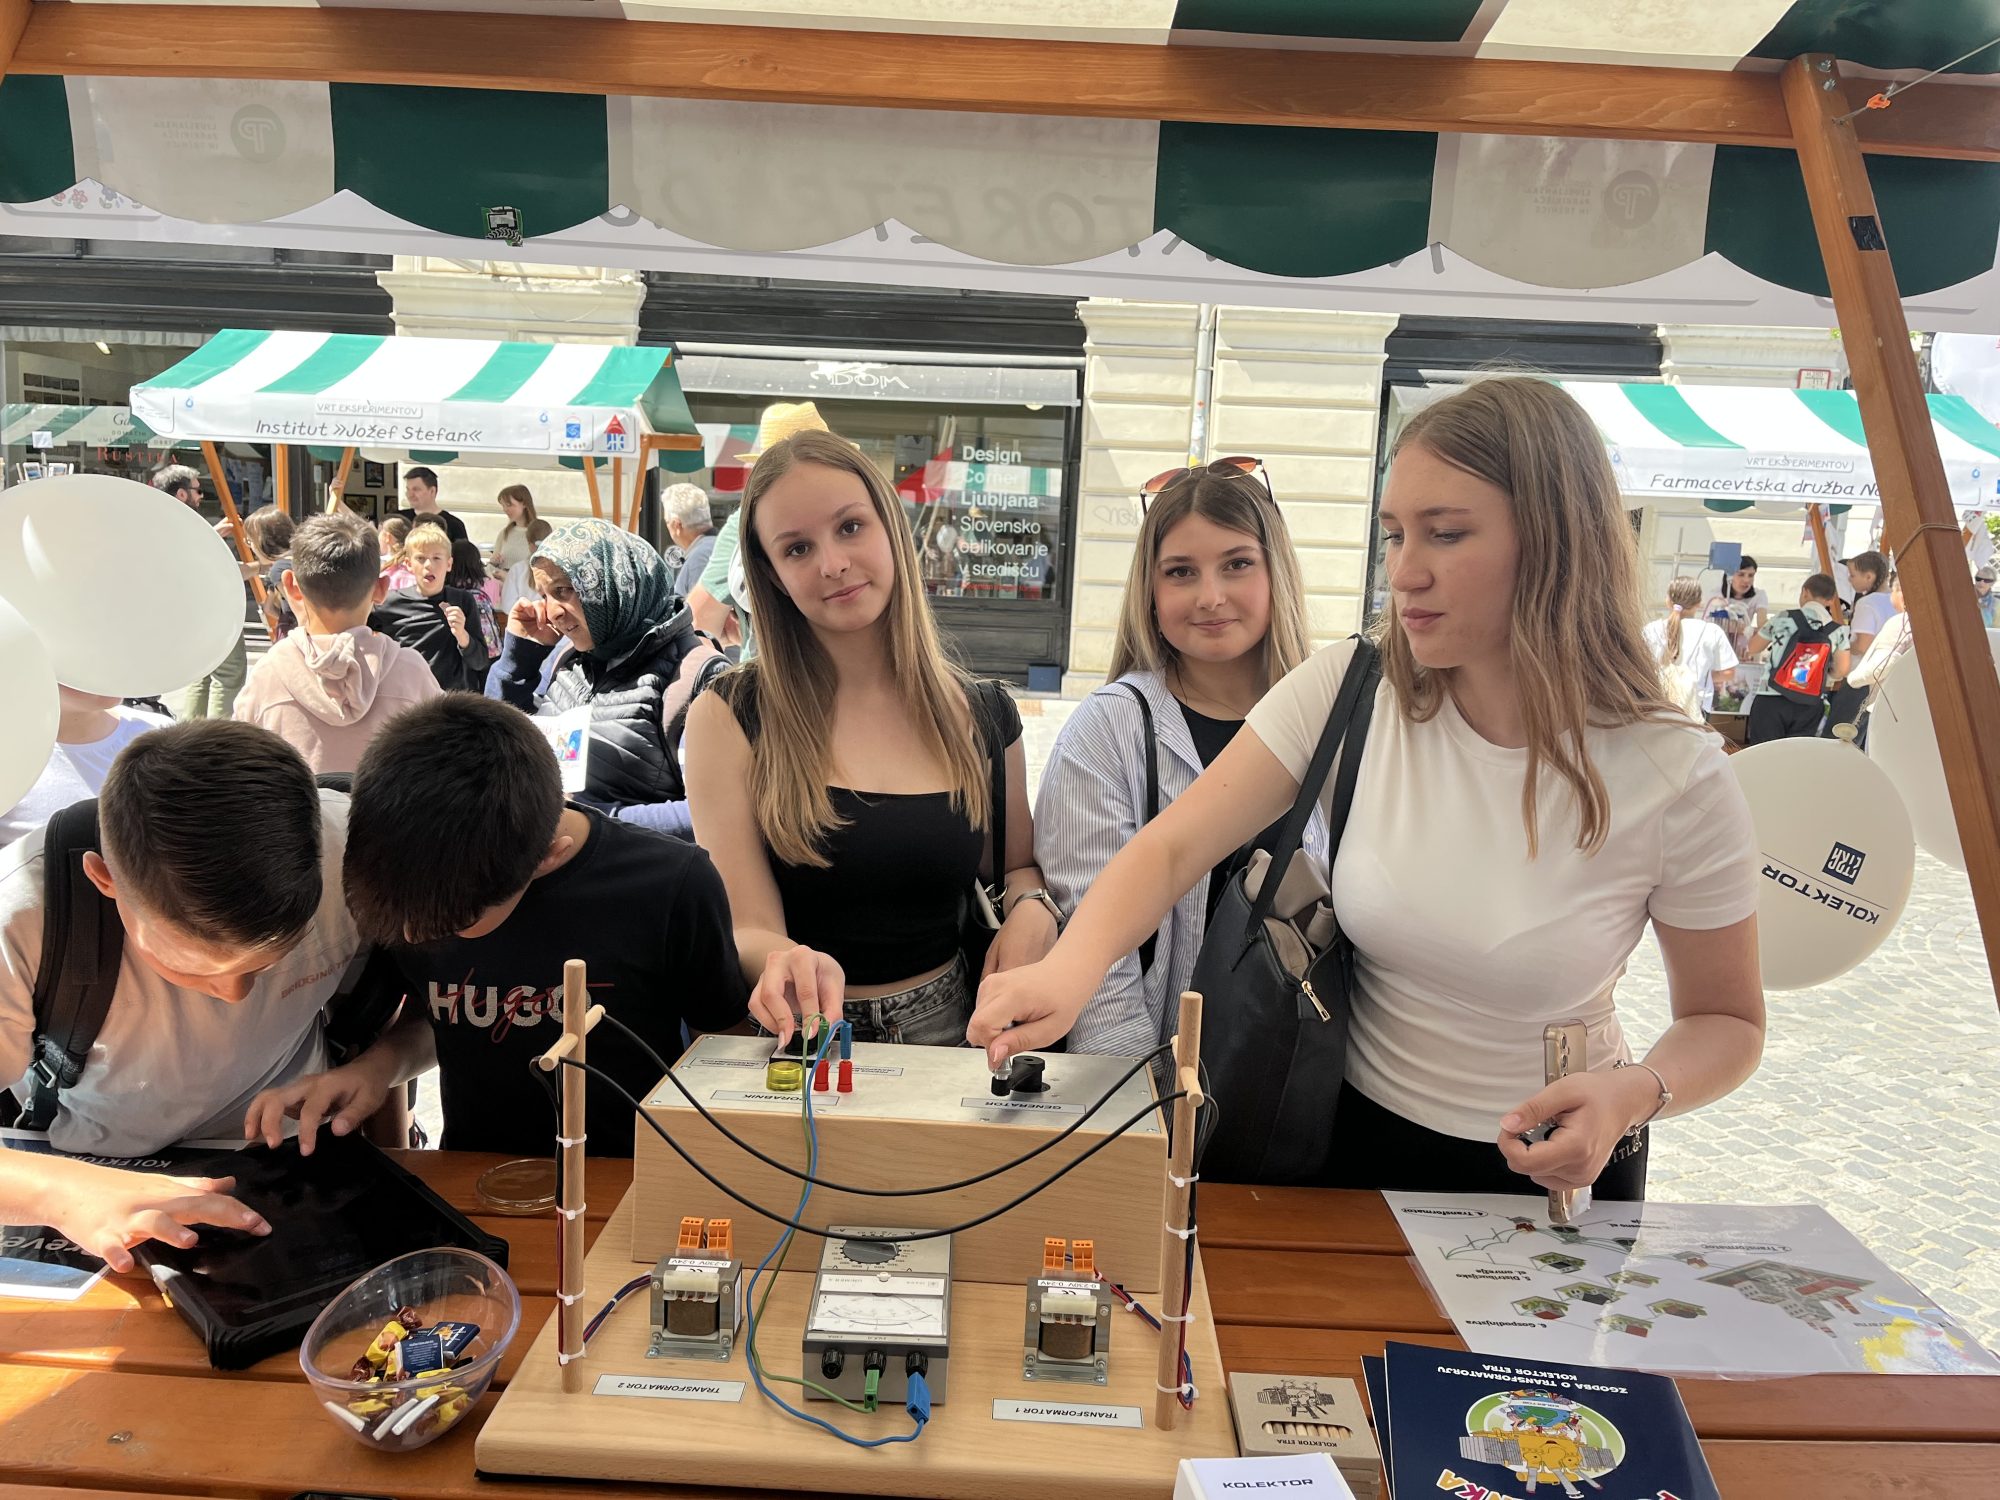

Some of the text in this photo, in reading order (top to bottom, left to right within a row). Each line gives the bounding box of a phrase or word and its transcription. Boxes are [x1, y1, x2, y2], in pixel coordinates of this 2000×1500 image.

[316, 402, 417, 416] VRT EKSPERIMENTOV
[256, 420, 482, 443] Institut »Jožef Stefan«
[962, 445, 1022, 466] Design
[1746, 457, 1764, 466] VRT
[1650, 474, 1785, 493] Farmacevtska
[1791, 480, 1854, 497] družba
[961, 490, 1039, 511] Ljubljana
[960, 515, 1041, 534] Slovensko
[959, 540, 1048, 560] oblikovanje
[971, 563, 1040, 579] središču
[1761, 864, 1880, 925] KOLEKTOR
[985, 1101, 1062, 1110] GENERATOR
[1465, 1320, 1536, 1328] Gospodinjstva
[1437, 1366, 1557, 1387] TRANSFORMATORJU
[1482, 1364, 1577, 1381] KOLEKTOR ETRA
[626, 1383, 721, 1393] TRANSFORMATOR
[1574, 1382, 1628, 1394] ZGODBA
[1023, 1408, 1118, 1419] TRANSFORMATOR
[1297, 1440, 1338, 1448] KOLEKTOR
[1222, 1479, 1313, 1489] KOLEKTOR
